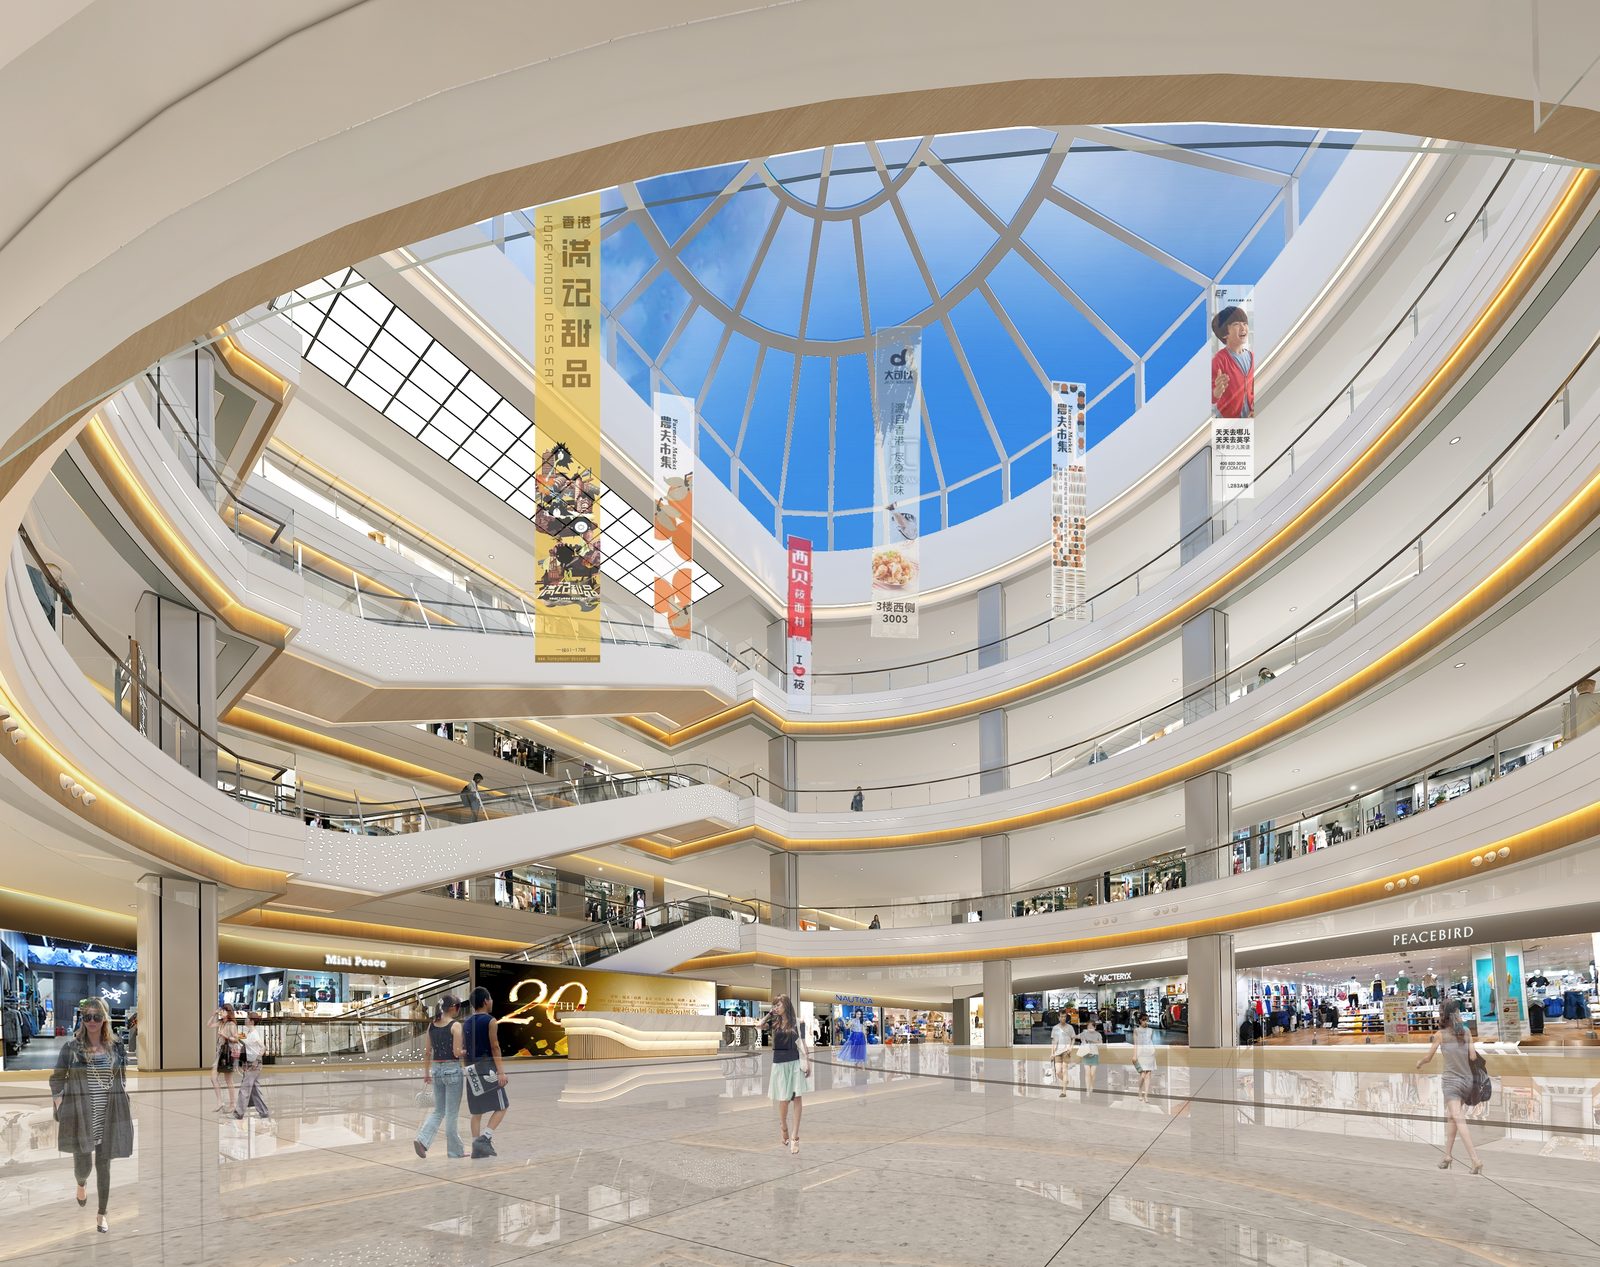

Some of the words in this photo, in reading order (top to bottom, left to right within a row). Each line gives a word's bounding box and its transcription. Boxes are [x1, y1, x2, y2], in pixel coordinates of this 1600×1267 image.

[562, 215, 591, 229] 香港
[1215, 289, 1228, 297] EF
[561, 238, 592, 388] 满记甜品
[876, 601, 916, 613] 3楼西侧
[882, 614, 909, 624] 3003
[1393, 926, 1474, 946] PEACEBIRD
[325, 954, 352, 966] Mini
[354, 956, 387, 968] Peace
[497, 979, 588, 1025] 20
[558, 1002, 574, 1010] TH
[835, 994, 873, 1005] NAUTICA
[467, 1066, 481, 1093] adidas
